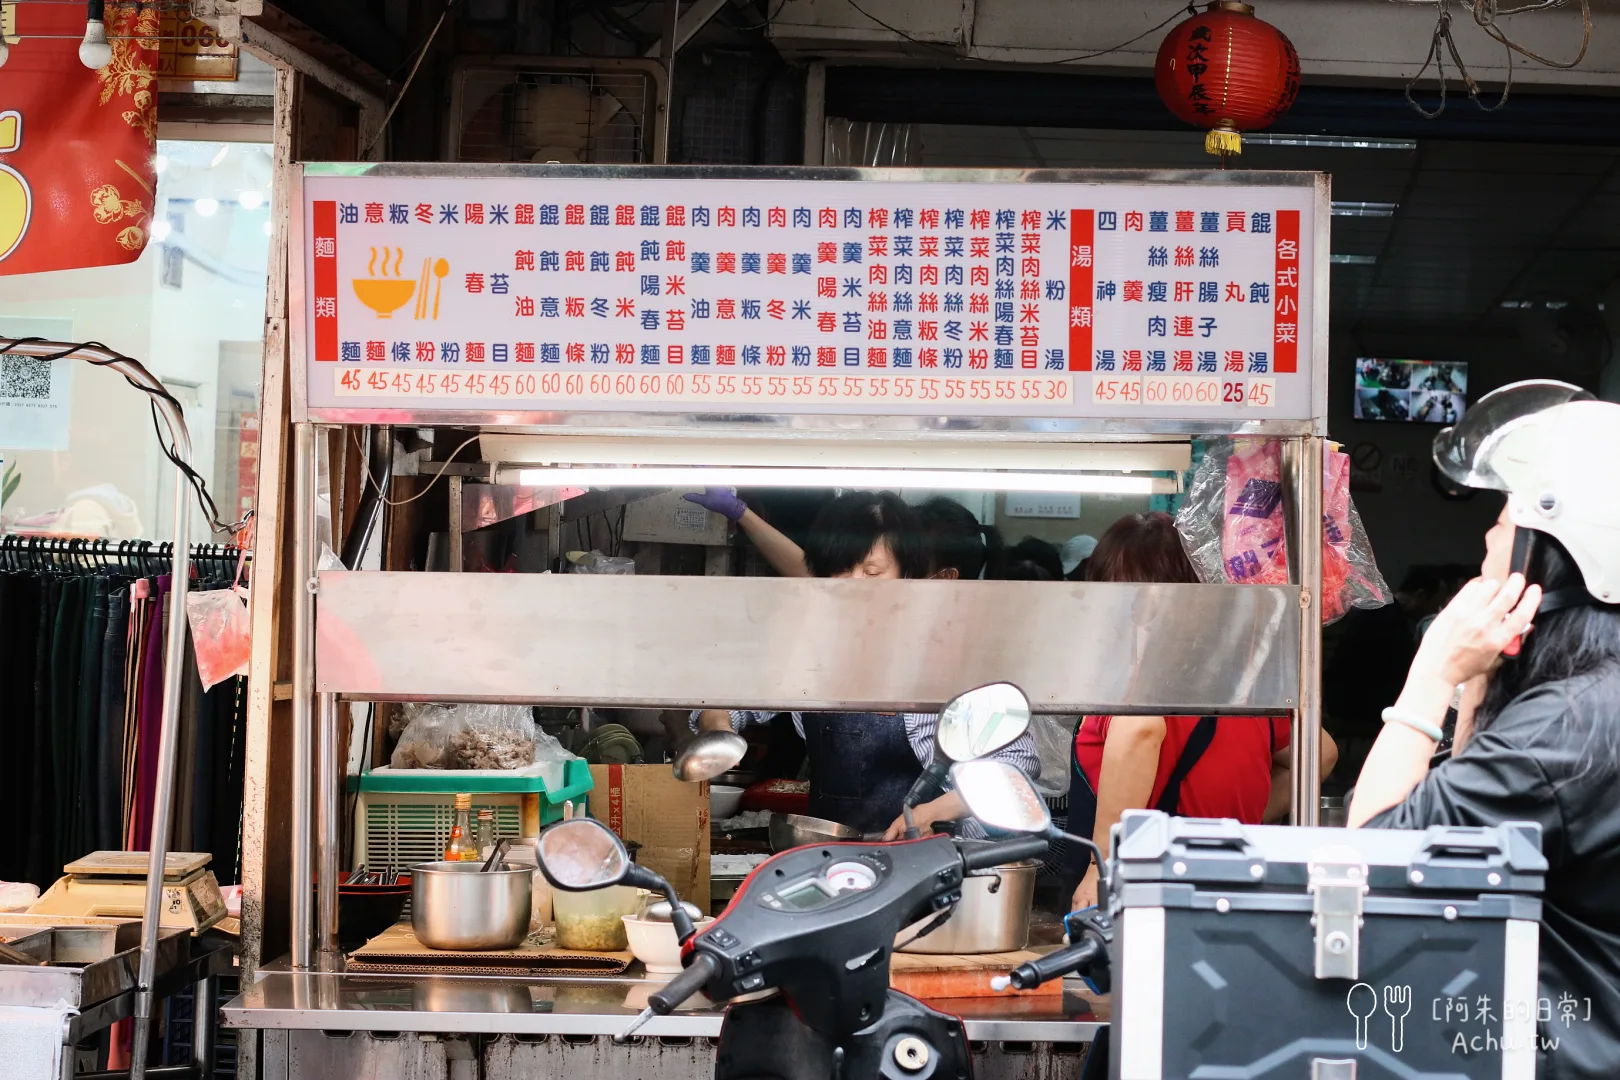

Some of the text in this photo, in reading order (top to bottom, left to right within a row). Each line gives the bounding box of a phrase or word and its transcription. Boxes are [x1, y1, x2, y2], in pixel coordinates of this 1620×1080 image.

[315, 236, 336, 318] 麵類
[340, 203, 361, 361] 油麵
[364, 202, 386, 361] 意麵
[414, 203, 435, 362] 冬粉
[438, 203, 460, 363] 米粉
[465, 203, 485, 362] 陽春麵
[490, 204, 509, 362] 米苔目
[514, 204, 535, 362] 餛飩油麵
[540, 204, 560, 363] 餛飩意麵
[590, 205, 610, 364] 餛飩冬粉
[615, 205, 635, 364] 餛飩米粉
[640, 205, 660, 364] 餛飩陽春麵
[666, 205, 685, 364] 餛飩米苔目
[867, 208, 888, 368] 榨菜肉絲油麵
[893, 208, 913, 368] 榨菜肉絲意麵
[943, 208, 964, 368] 榨菜肉絲冬粉
[969, 209, 990, 369] 榨菜肉絲米粉
[994, 209, 1015, 369] 榨菜肉絲陽春麵
[1020, 210, 1041, 369] 榨菜肉絲米苔目
[1045, 210, 1066, 370] 米粉湯
[1070, 245, 1092, 328] 湯類
[1096, 211, 1117, 371] 四神湯
[1146, 211, 1168, 372] 薑絲瘦肉湯
[1173, 210, 1195, 372] 薑絲肝連湯
[1197, 211, 1220, 372] 薑絲腸子湯
[1224, 211, 1246, 372] 貢丸湯
[1248, 212, 1271, 373] 餛飩湯
[1275, 238, 1298, 343] 各式小菜
[341, 369, 1067, 399] 45 45 45 45 45 45 45 60 60 60 60 60 60 60 55 55 55 55 55 55 55 55 55 55 55 55 55 55 30
[1096, 380, 1272, 405] 45 45 60 60 60 25 45
